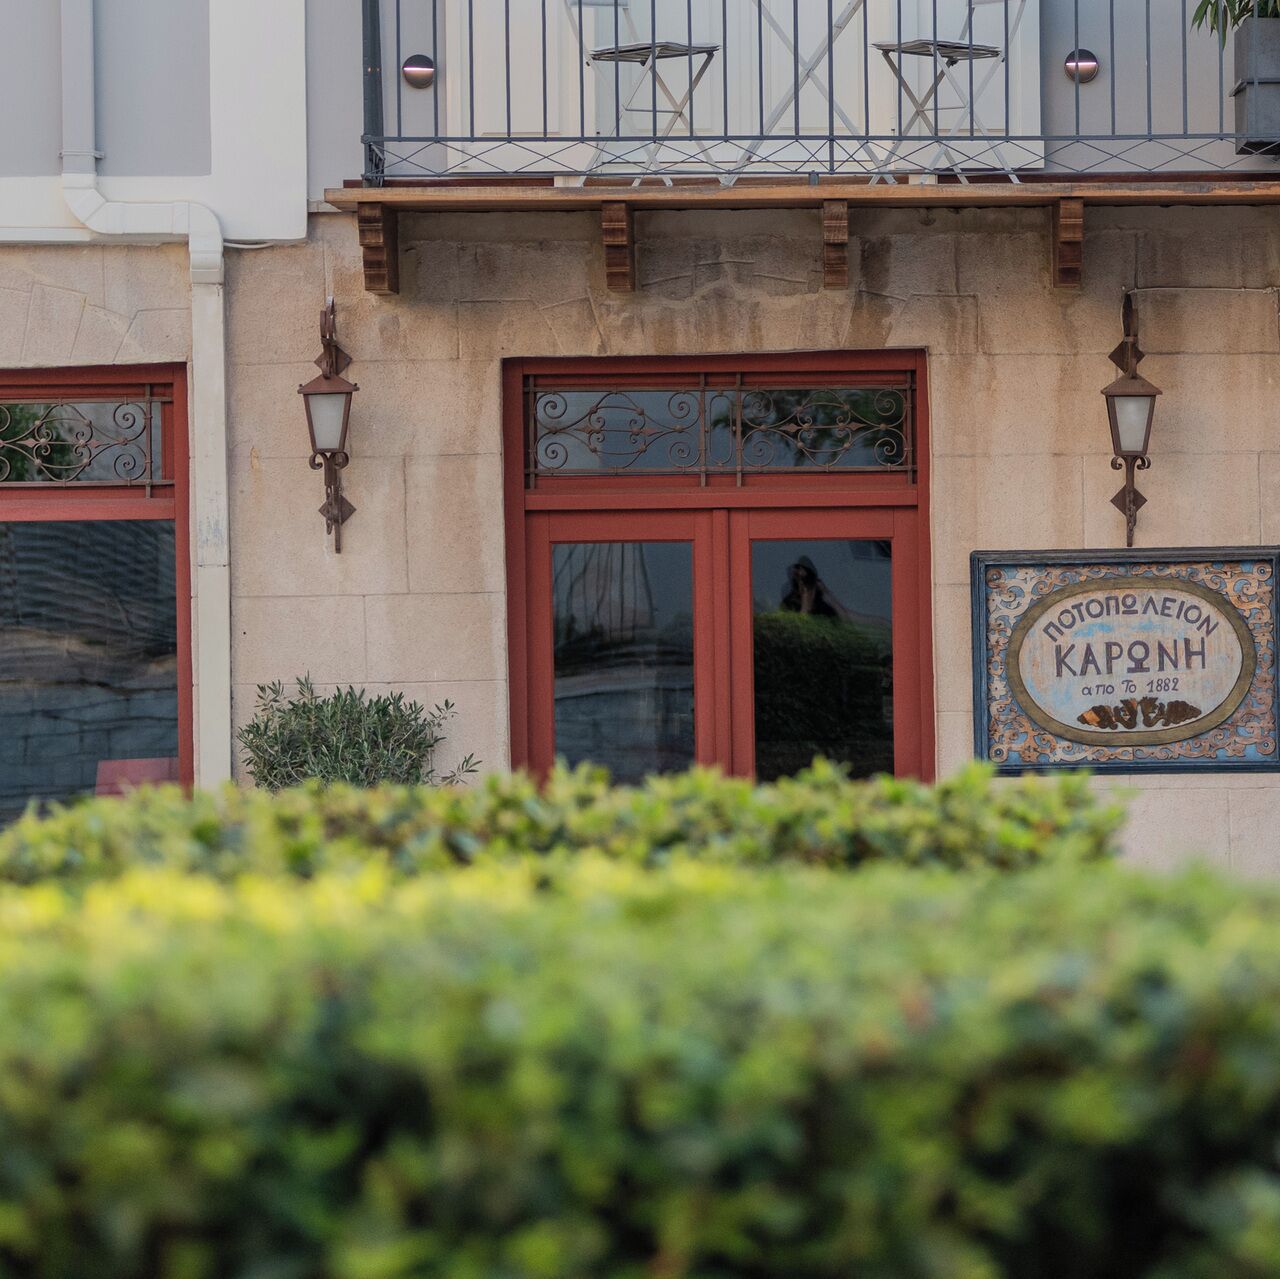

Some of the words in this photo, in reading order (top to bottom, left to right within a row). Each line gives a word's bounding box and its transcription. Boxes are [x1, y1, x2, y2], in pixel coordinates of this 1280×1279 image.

[1042, 593, 1219, 642] ΠΟΤΟΠΩΛΕΙΟΝ
[1053, 636, 1207, 677] ΚΑΡΩΝΗ
[1146, 677, 1180, 693] 1882
